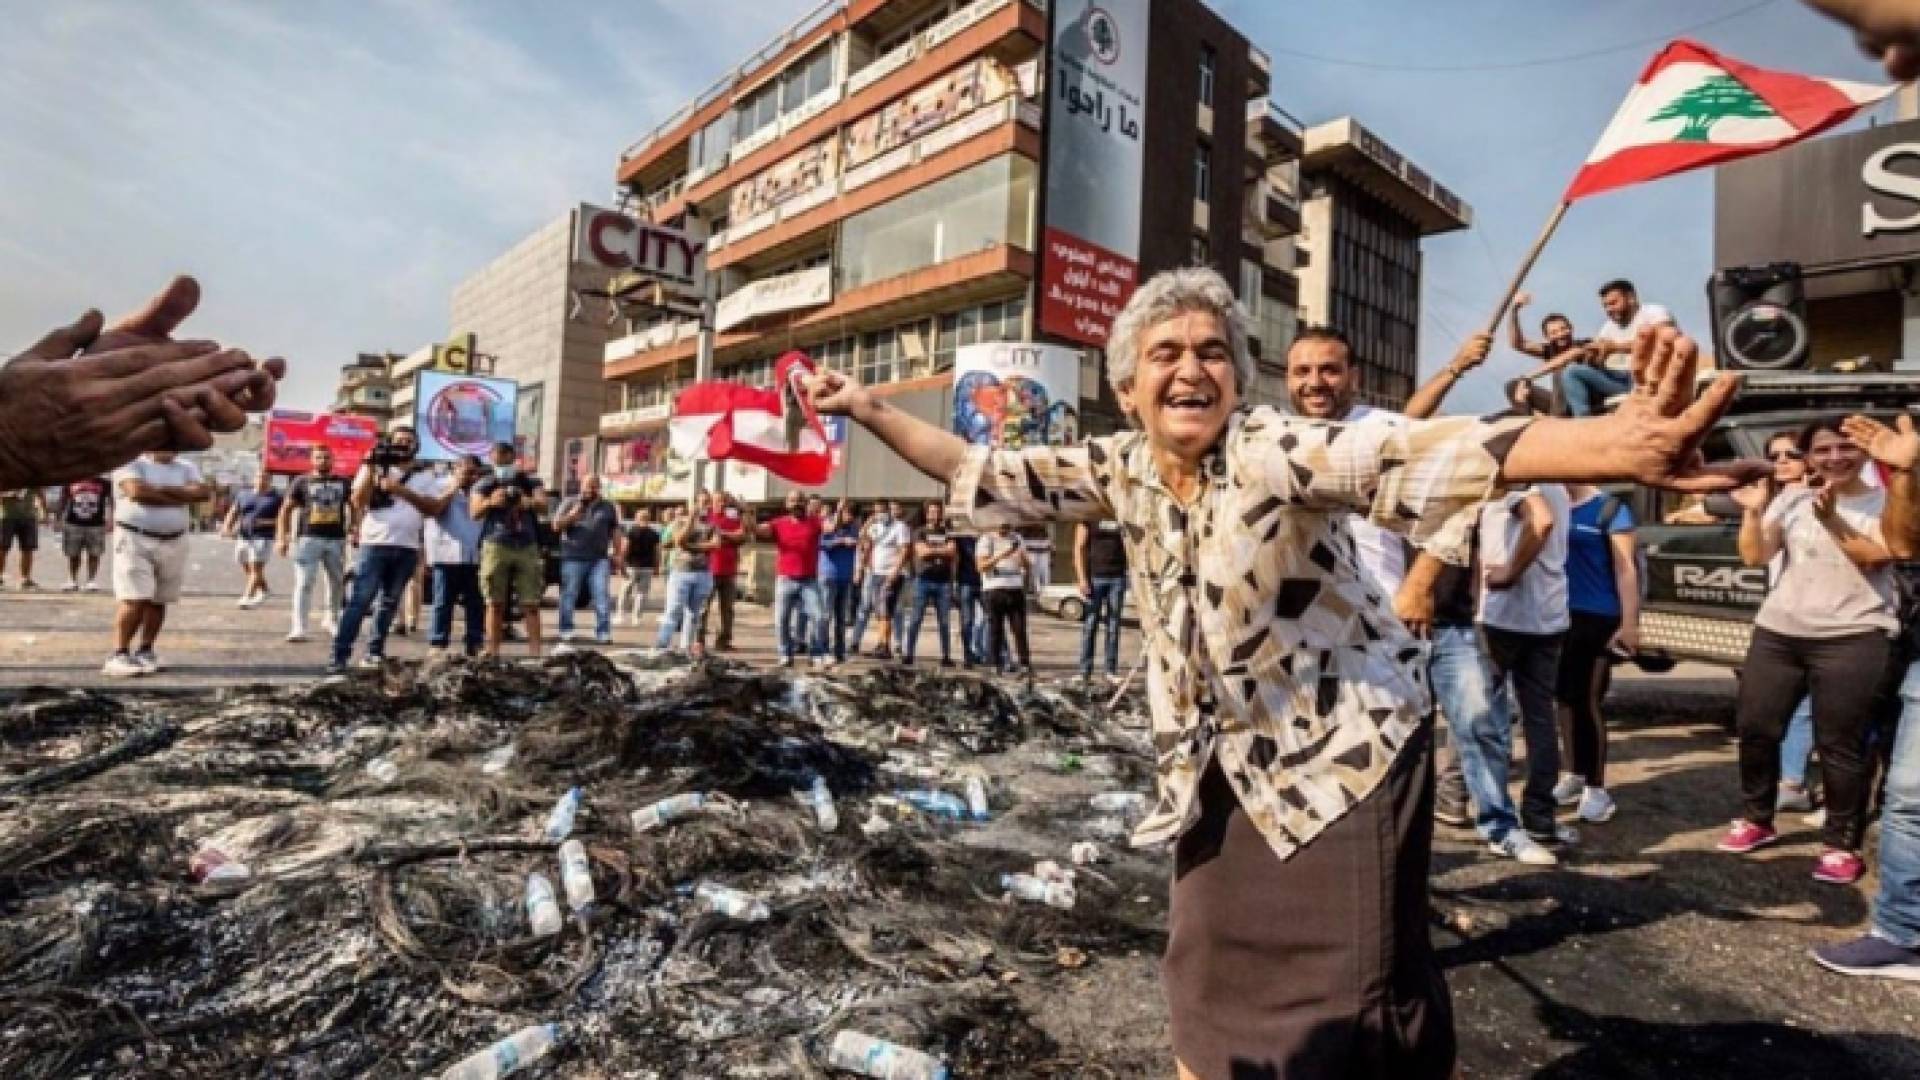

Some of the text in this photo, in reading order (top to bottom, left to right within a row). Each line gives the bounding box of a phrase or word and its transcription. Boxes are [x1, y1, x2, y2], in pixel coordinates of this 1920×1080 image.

[1059, 69, 1111, 132] راحوا
[1119, 104, 1138, 140] ما
[589, 210, 704, 276] CITY
[445, 347, 500, 376] CTY
[993, 346, 1043, 368] CITY
